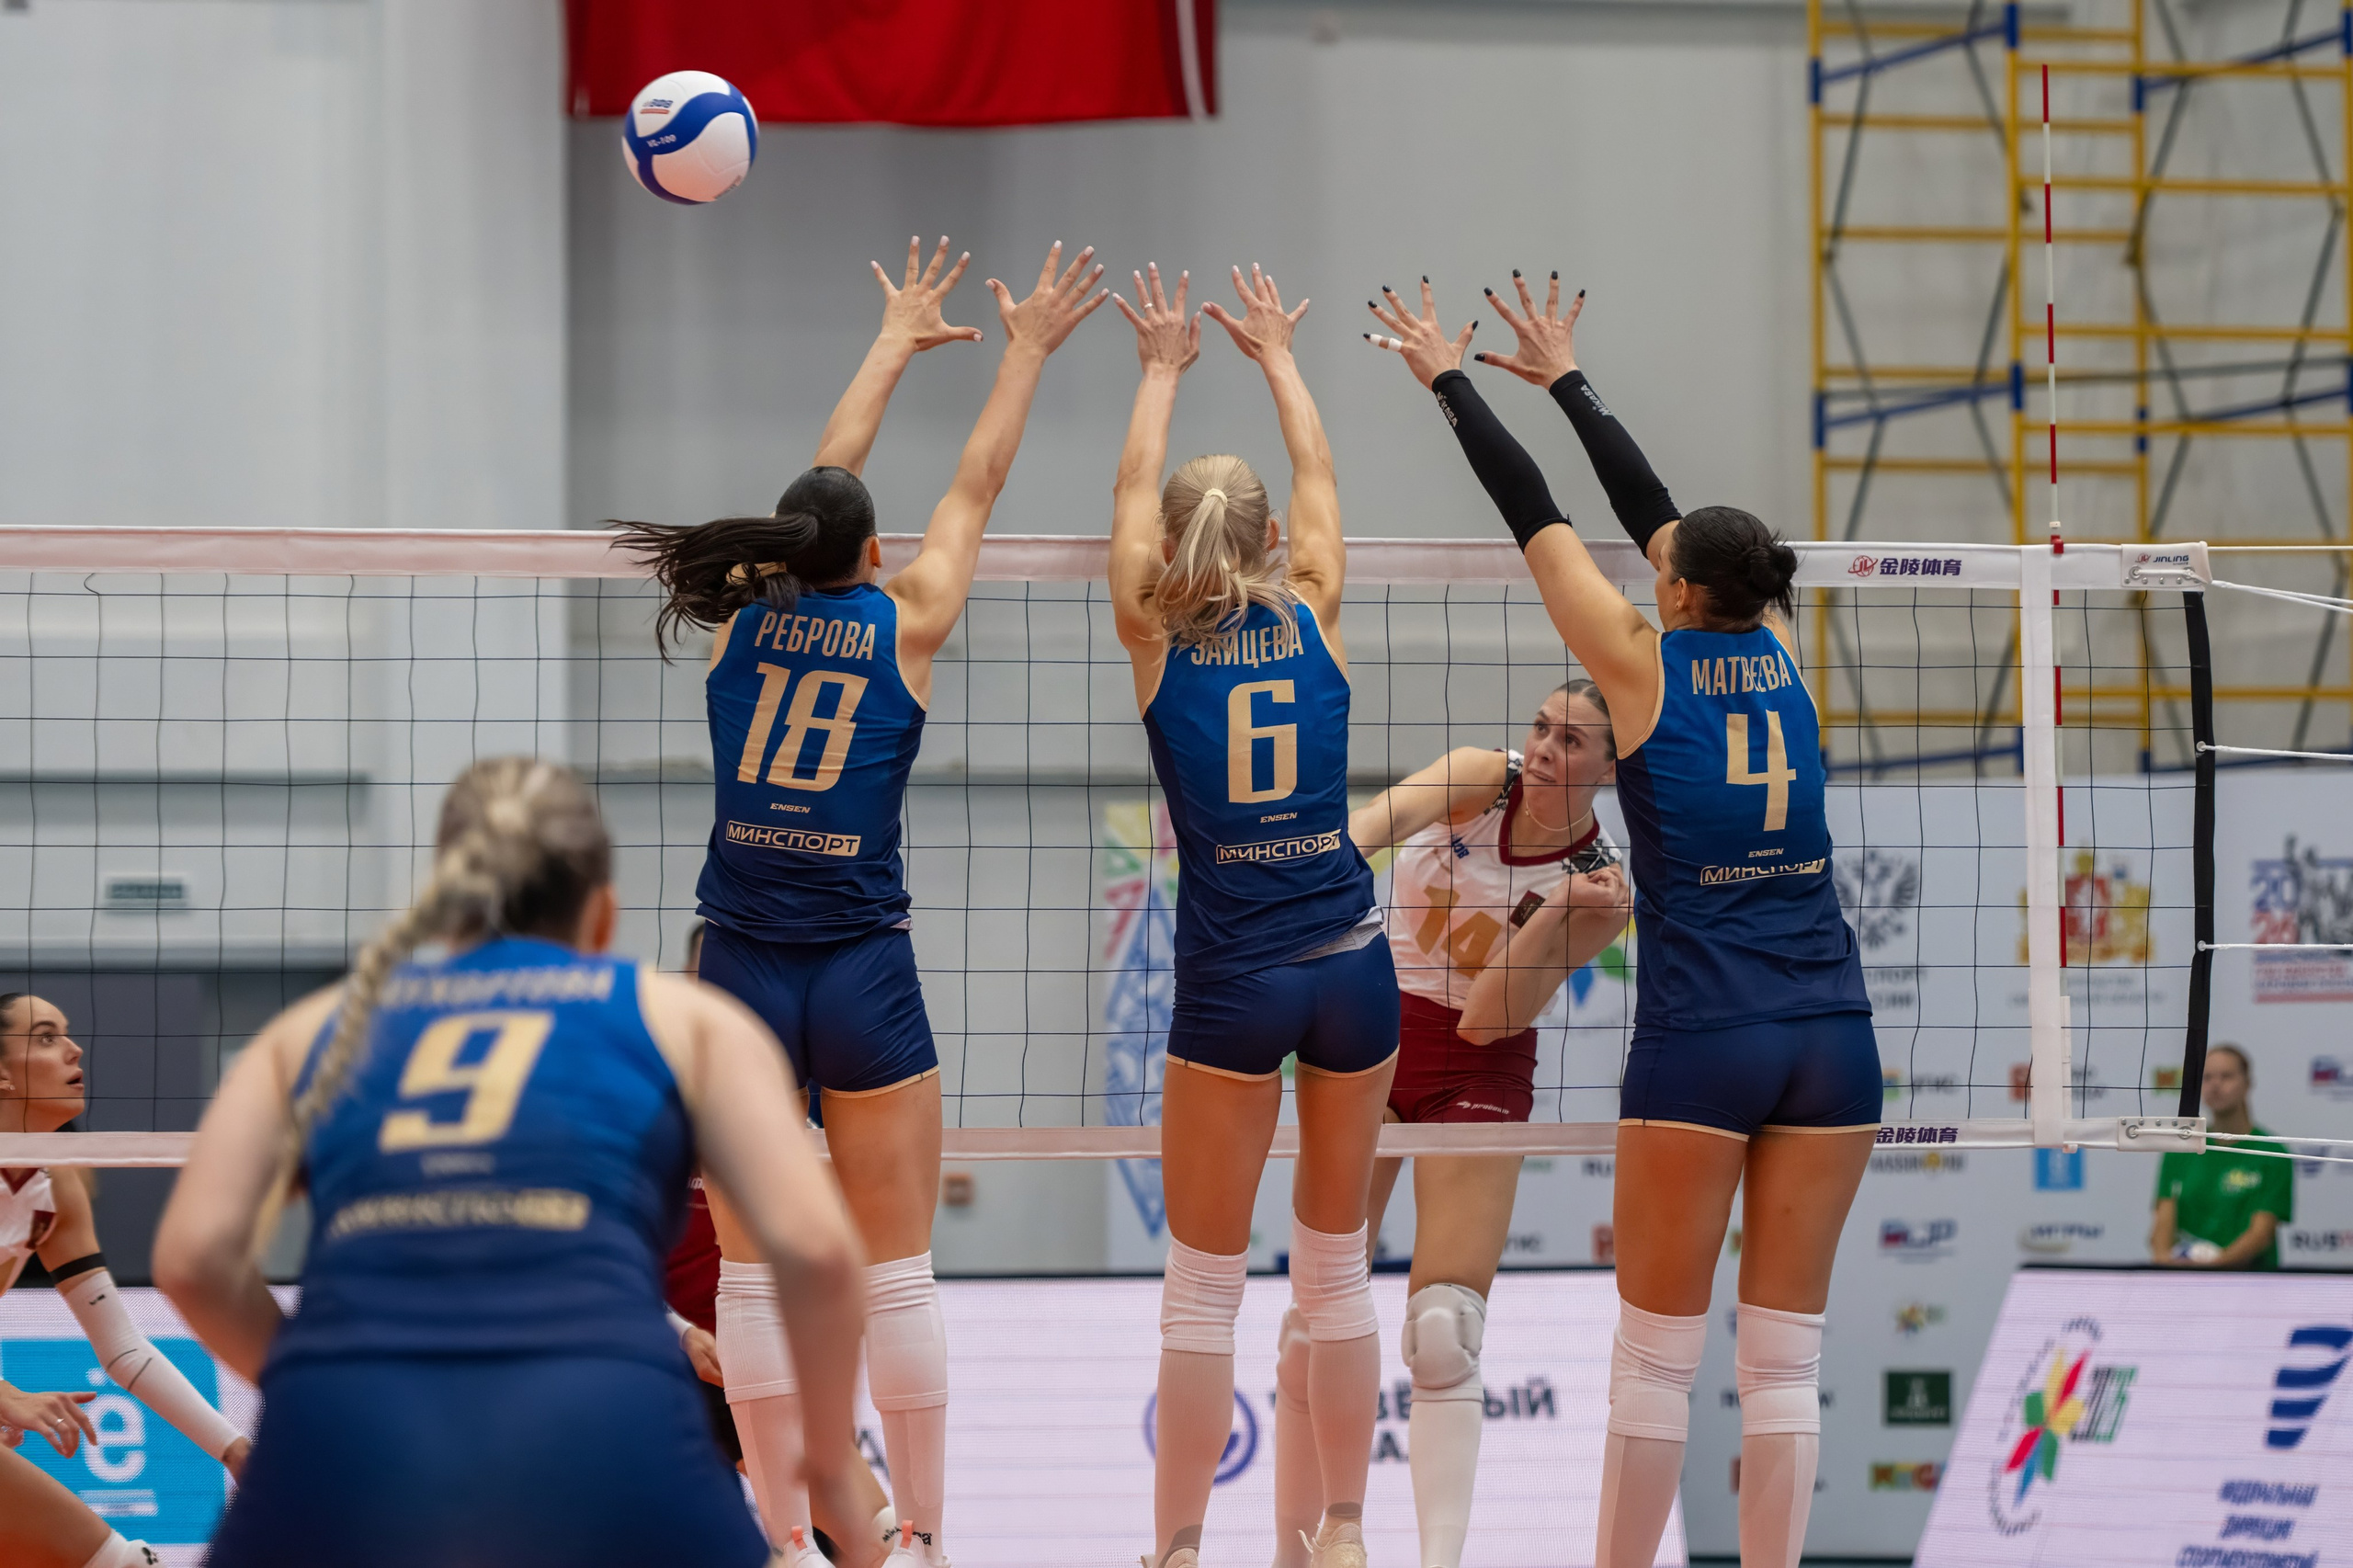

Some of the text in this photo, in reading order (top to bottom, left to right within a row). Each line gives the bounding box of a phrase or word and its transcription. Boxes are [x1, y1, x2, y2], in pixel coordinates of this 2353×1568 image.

[1580, 384, 1613, 416] MIKASA
[1880, 558, 1961, 576] 金陵体育
[2153, 555, 2189, 563] JINLING
[754, 610, 876, 661] РЕБРОВА
[737, 661, 870, 792] 18
[1227, 679, 1298, 804] 6
[1725, 709, 1797, 832] 4
[769, 802, 811, 814] ENSEN
[1259, 812, 1298, 824] ENSEN
[727, 824, 859, 854] МИНСПОРТ
[1220, 833, 1340, 861] МИНСПОРТ
[1748, 847, 1784, 858] ENSEN
[1415, 885, 1502, 980] 14
[377, 1011, 556, 1154] 9
[1876, 1127, 1959, 1144] 金陵体育
